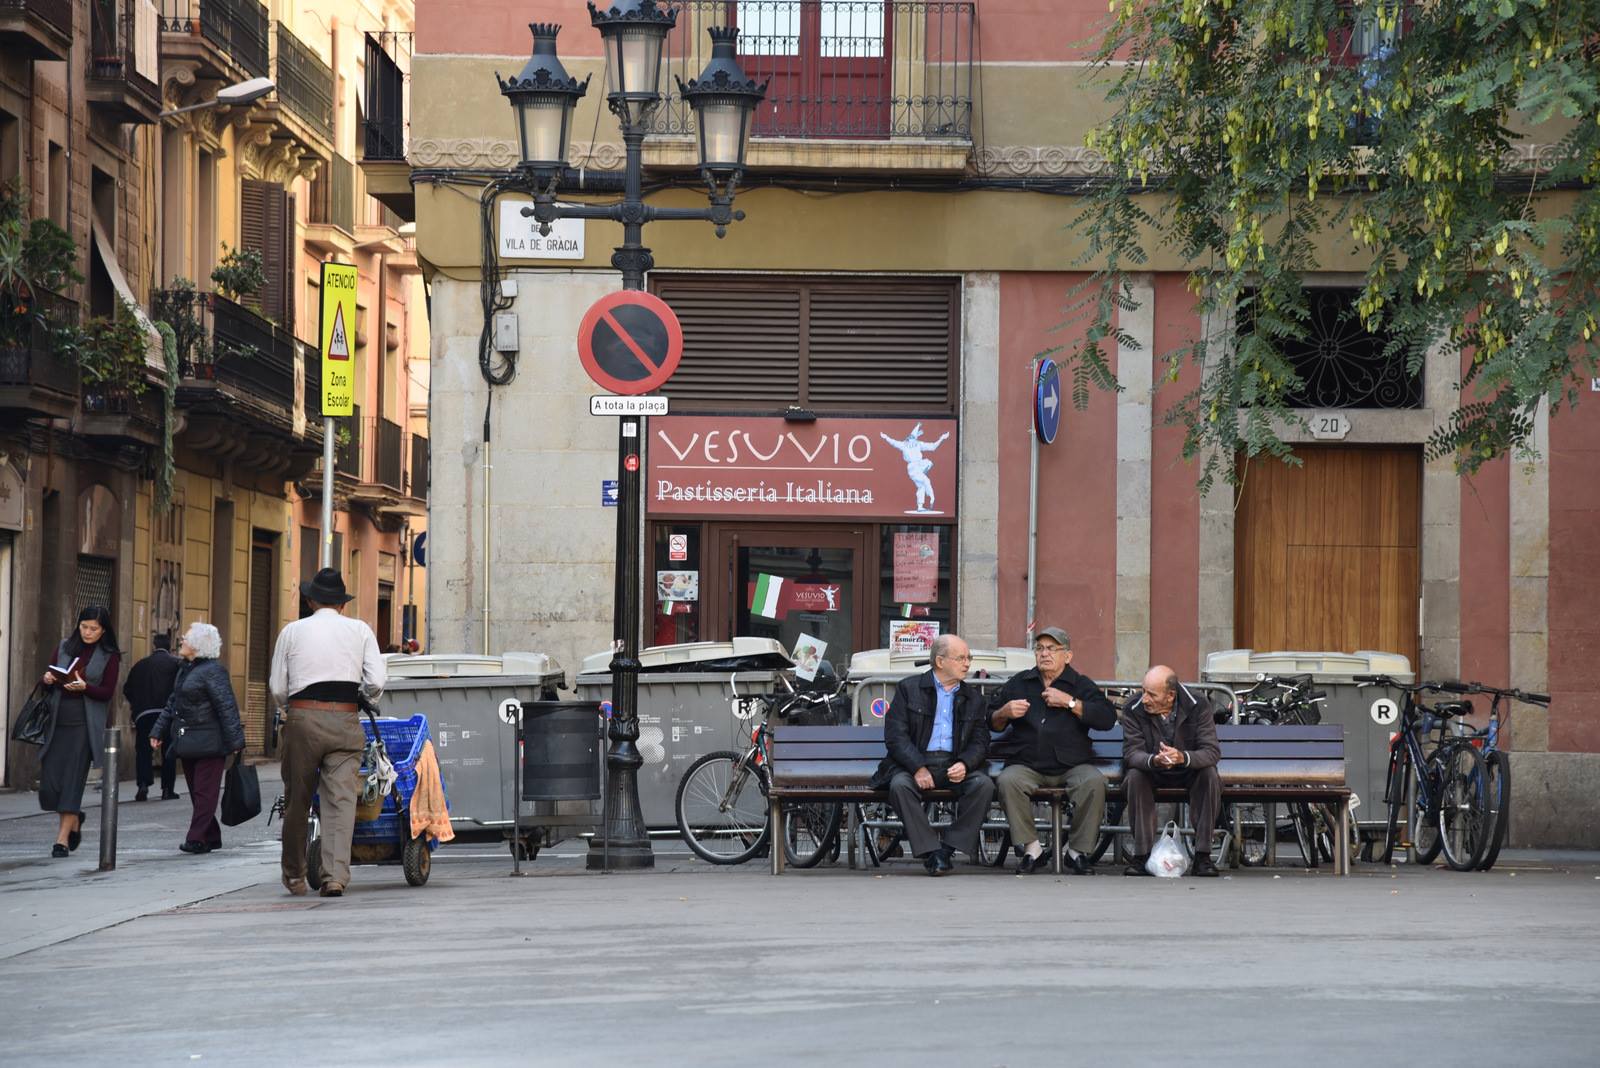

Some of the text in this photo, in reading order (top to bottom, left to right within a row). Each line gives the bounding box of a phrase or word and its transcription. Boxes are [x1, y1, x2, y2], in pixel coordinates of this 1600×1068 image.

[505, 236, 578, 251] VILA DE GRÀCIA
[326, 271, 355, 289] ATENCIÓ
[331, 371, 347, 387] Zona
[327, 392, 350, 408] Escolar
[595, 400, 665, 412] A tota la plaça
[1320, 418, 1339, 433] 20
[657, 429, 872, 464] VESUVIO
[657, 479, 873, 504] Pastisseria Italiana
[795, 591, 825, 599] VESUVIO
[1377, 704, 1390, 719] R
